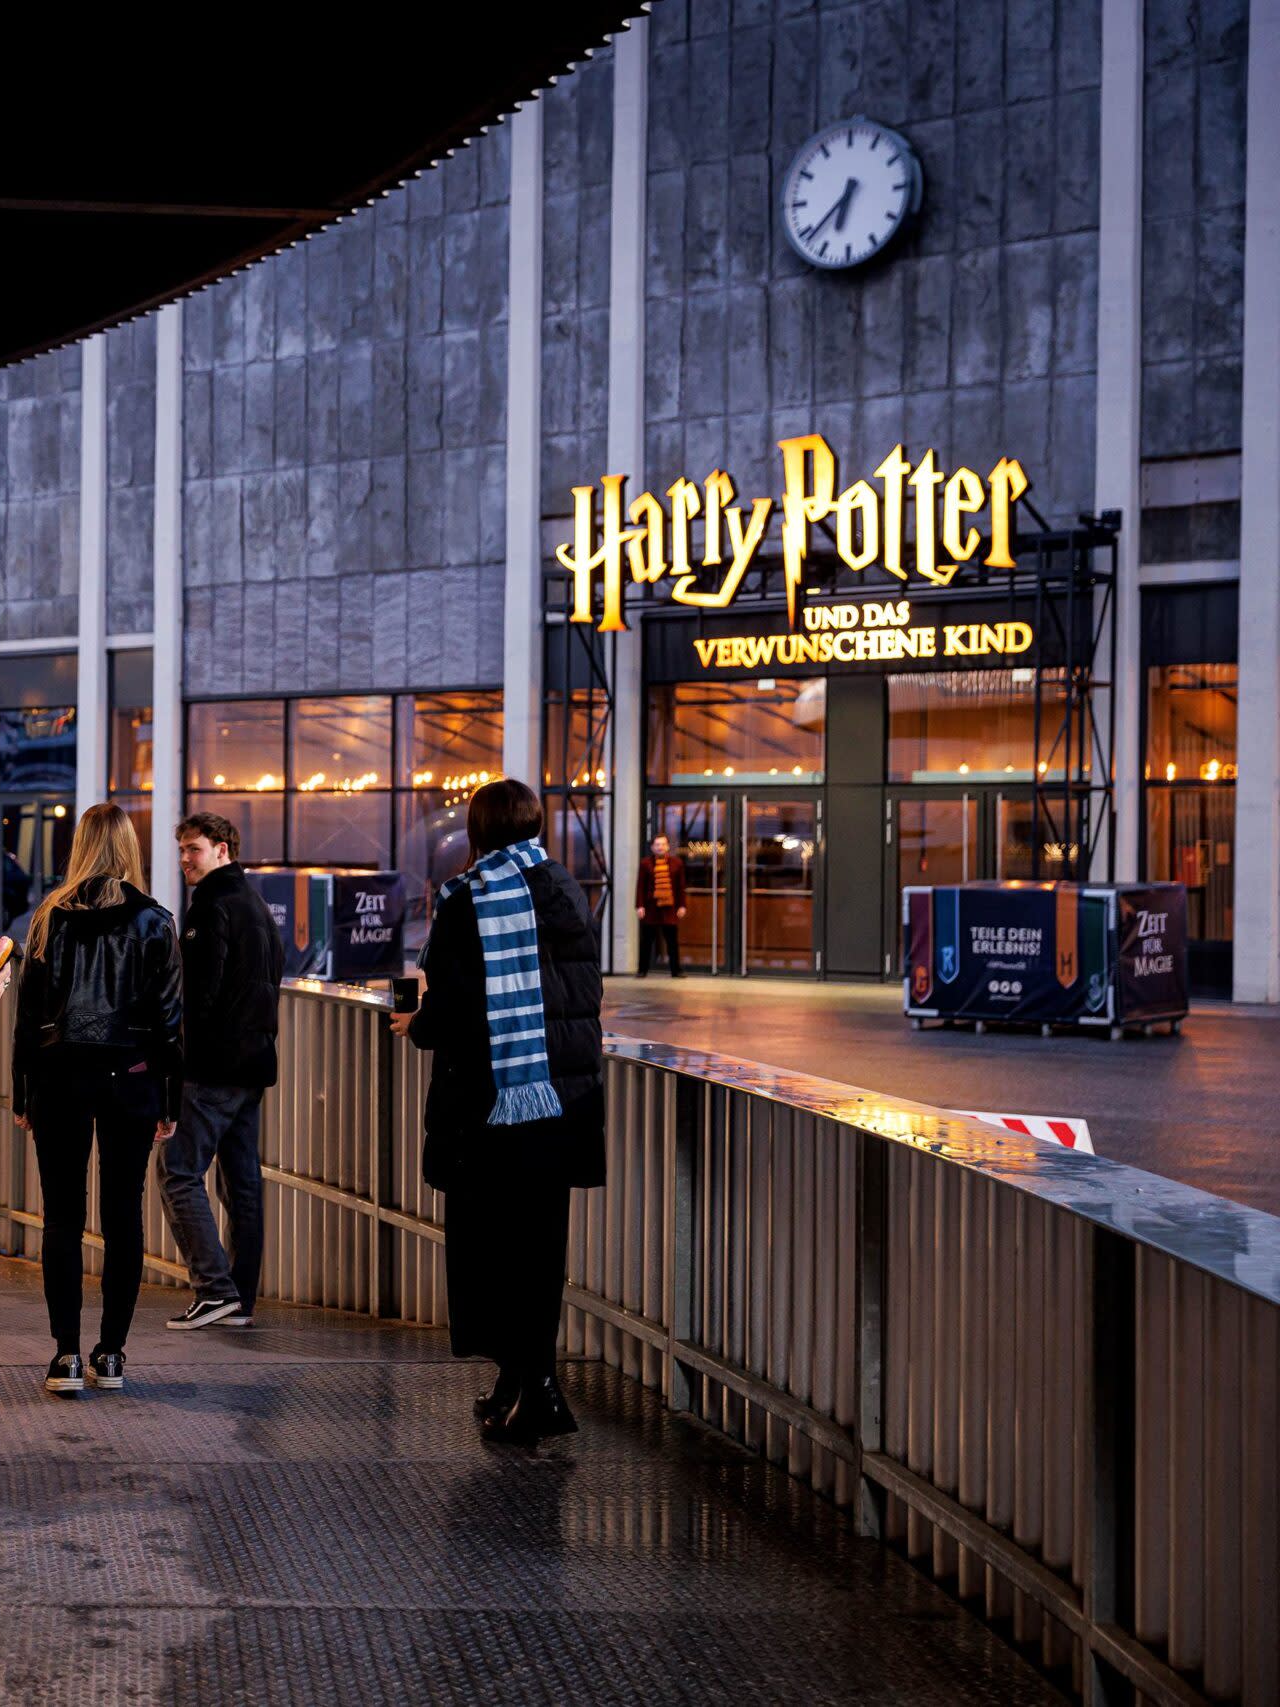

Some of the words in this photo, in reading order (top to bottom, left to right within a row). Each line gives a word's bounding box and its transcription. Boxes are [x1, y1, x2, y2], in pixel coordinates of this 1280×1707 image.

[555, 468, 772, 632] Harry
[777, 433, 1028, 630] Potter
[803, 604, 859, 630] UND
[862, 600, 911, 629] DAS
[694, 626, 936, 669] VERWUNSCHENE
[943, 621, 1034, 656] KIND
[970, 926, 1006, 941] TEILE
[1007, 927, 1042, 942] DEIN
[972, 940, 1041, 956] ERLEBNIS!
